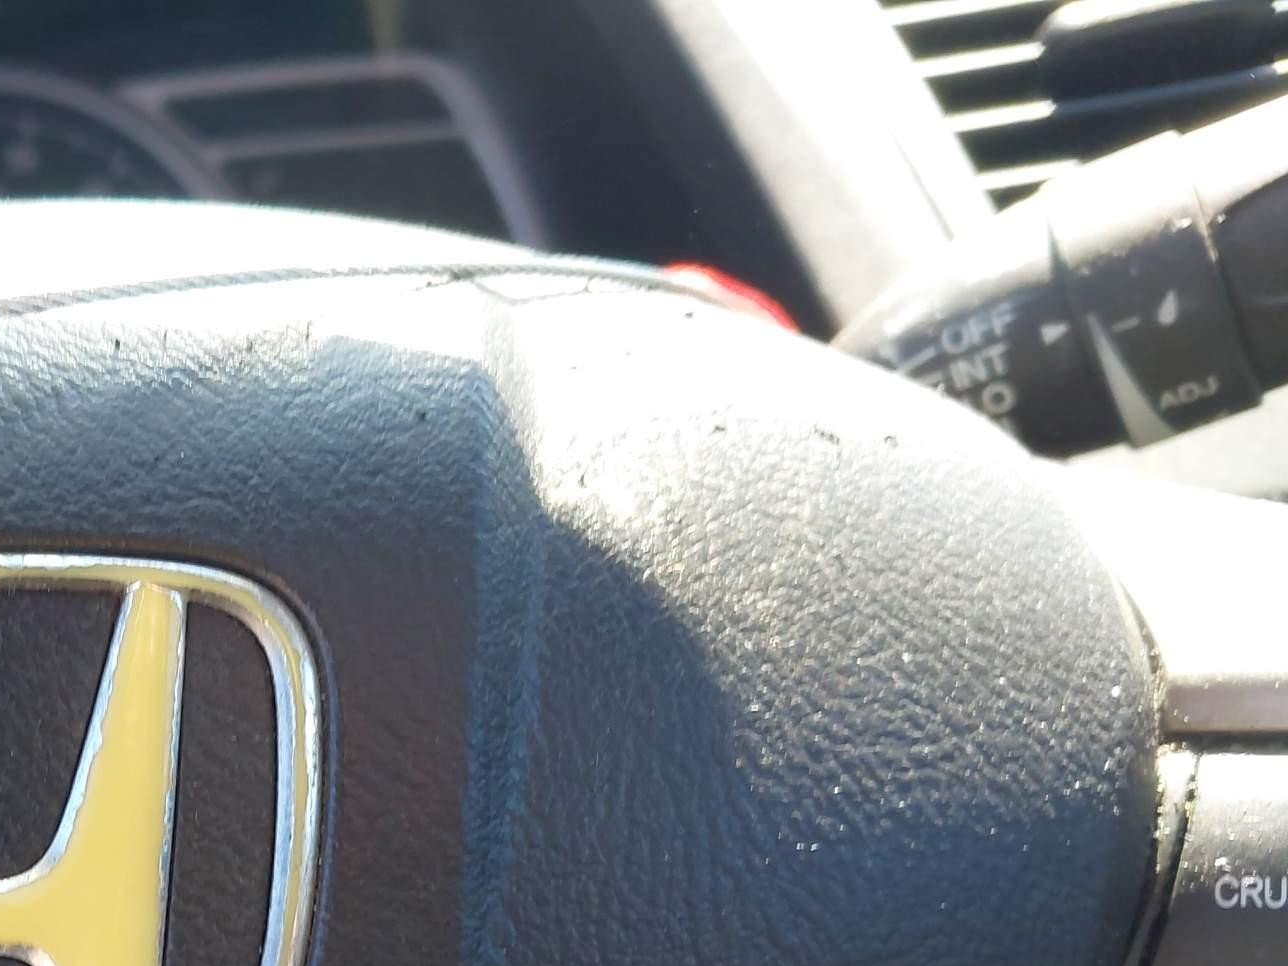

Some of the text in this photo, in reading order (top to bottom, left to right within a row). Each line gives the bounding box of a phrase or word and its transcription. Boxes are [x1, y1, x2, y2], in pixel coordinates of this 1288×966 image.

[942, 303, 1015, 354] OFF
[950, 343, 1009, 389] INT
[1158, 376, 1219, 408] ADJ
